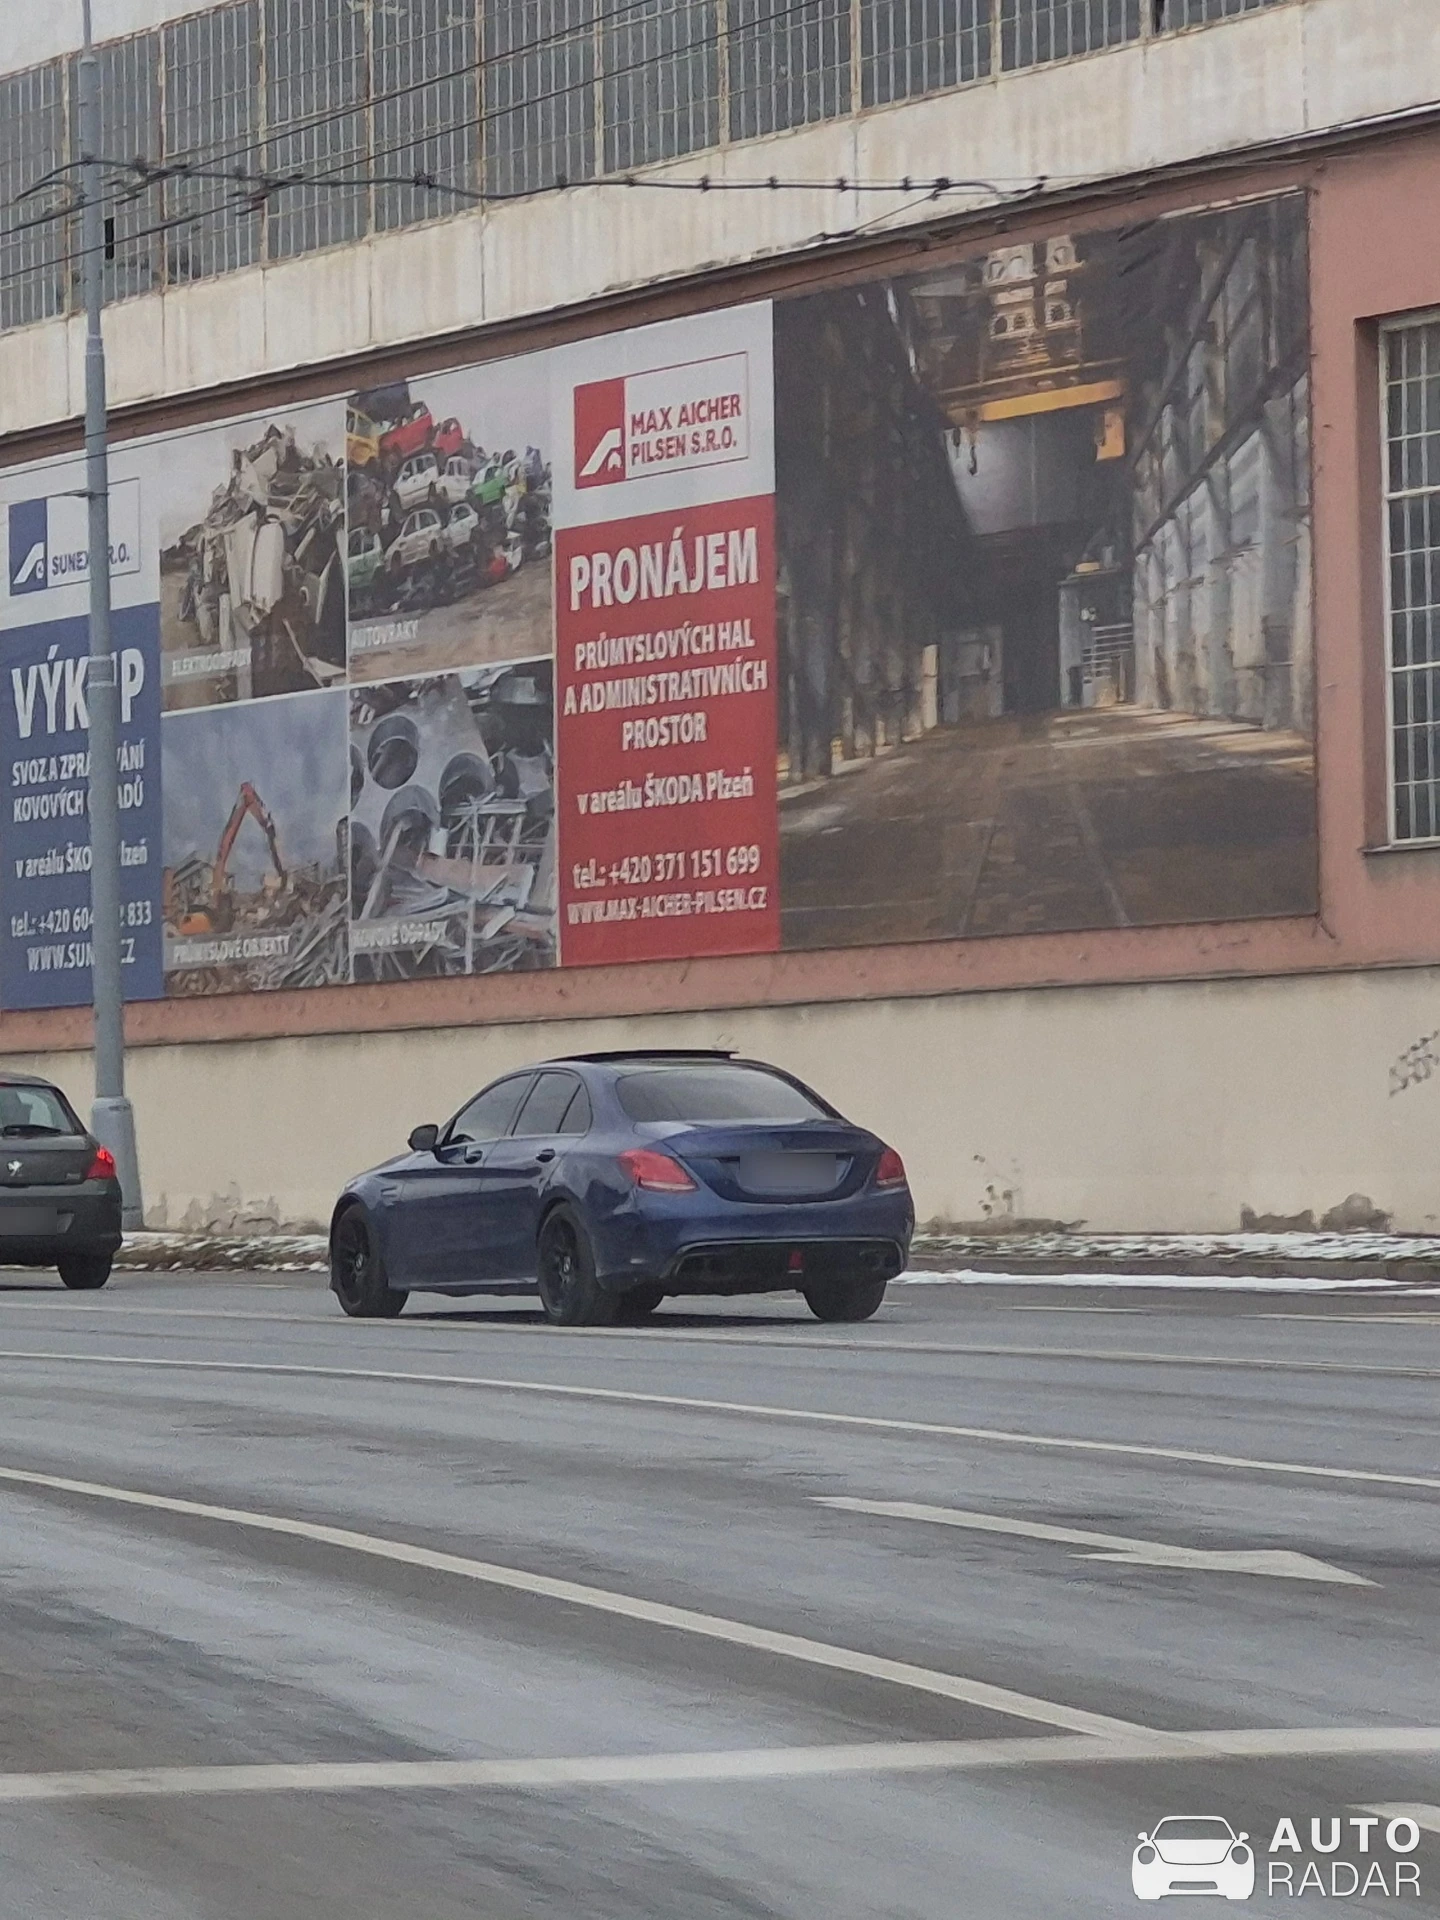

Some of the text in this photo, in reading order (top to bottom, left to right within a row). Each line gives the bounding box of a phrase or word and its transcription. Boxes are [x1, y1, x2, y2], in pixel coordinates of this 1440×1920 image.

[630, 393, 742, 437] MAX AICHER
[630, 425, 737, 466] PILSEN S.R.O.
[52, 550, 89, 577] SUNE
[569, 526, 760, 611] PRONÁJEM
[718, 618, 756, 651] HAL
[11, 643, 145, 739] VÝKP
[563, 655, 769, 717] A ADMINISTRATIVNÍCH
[622, 711, 708, 752] PROSTOR
[12, 757, 48, 787] SVOZ
[48, 755, 59, 782] A
[577, 766, 755, 815] v areálu ŠKODA Plzeň
[13, 786, 84, 823] KOVOVÝCH
[15, 859, 24, 879] v
[25, 848, 64, 878] areálu
[120, 838, 148, 867] lzeň
[608, 854, 651, 886] +420
[654, 851, 686, 882] 371
[690, 847, 722, 879] 151
[726, 844, 761, 876] 699
[37, 908, 70, 935] +420
[127, 900, 152, 927] 833
